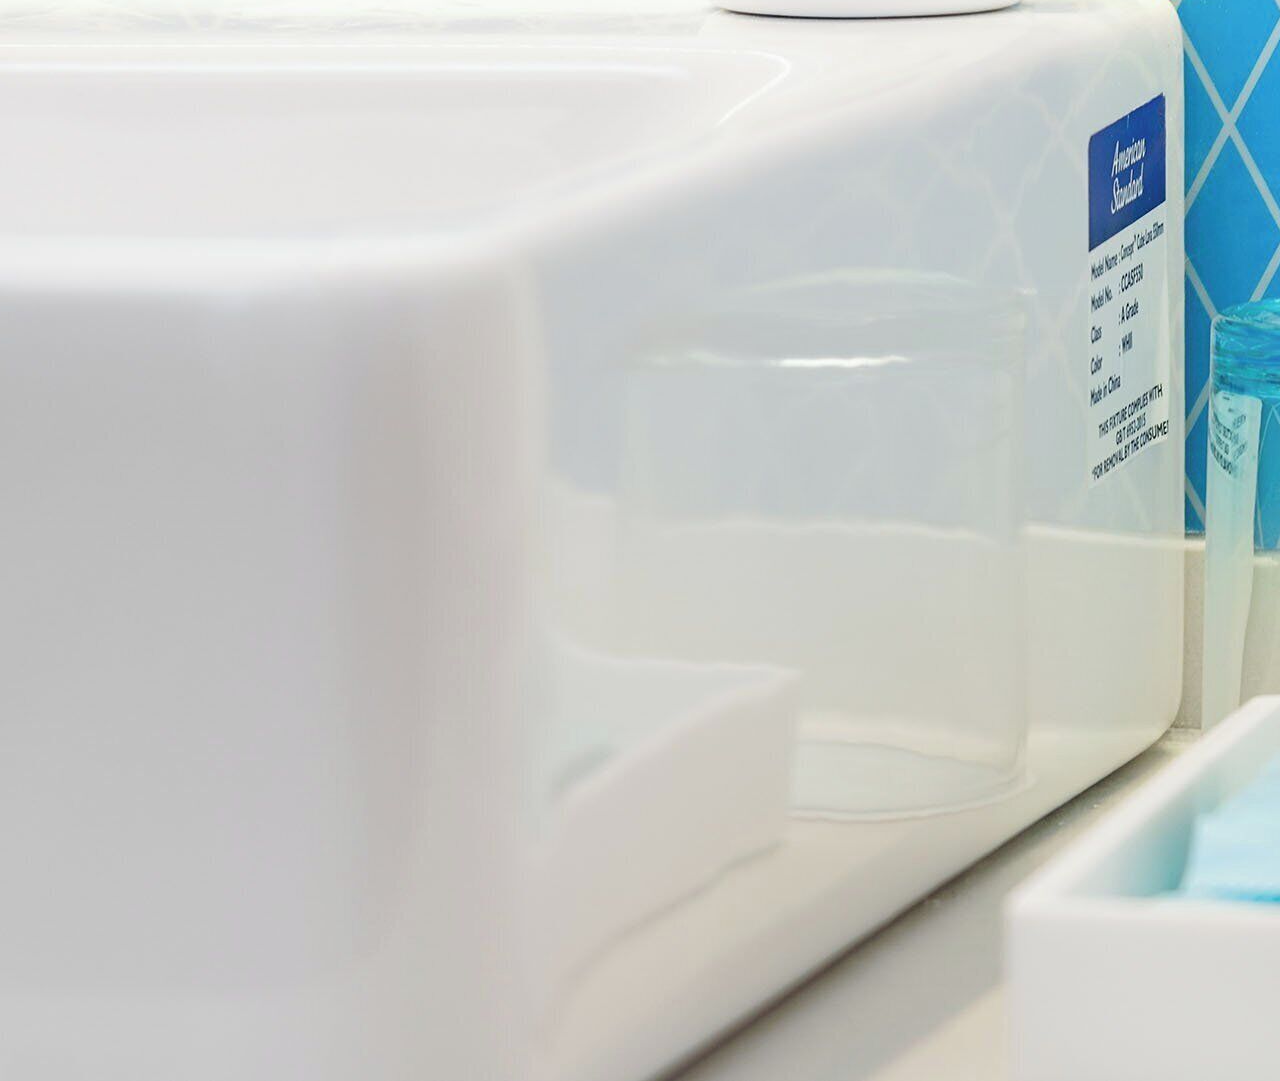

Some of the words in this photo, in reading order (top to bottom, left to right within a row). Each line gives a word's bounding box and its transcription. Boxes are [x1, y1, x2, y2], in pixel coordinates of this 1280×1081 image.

[1111, 137, 1146, 178] American
[1110, 162, 1145, 215] Standard
[1091, 258, 1104, 281] Model
[1105, 253, 1118, 273] Name
[1091, 288, 1104, 313] Model
[1126, 298, 1139, 321] Grade
[1090, 384, 1102, 408] Made
[1108, 374, 1121, 394] China
[1098, 419, 1109, 439] THIS
[1109, 406, 1127, 430] FIXTURE
[1128, 391, 1148, 418] COMPLIES
[1149, 383, 1163, 402] WITH
[1104, 447, 1124, 474] REMOVAL
[1131, 435, 1139, 455] THE
